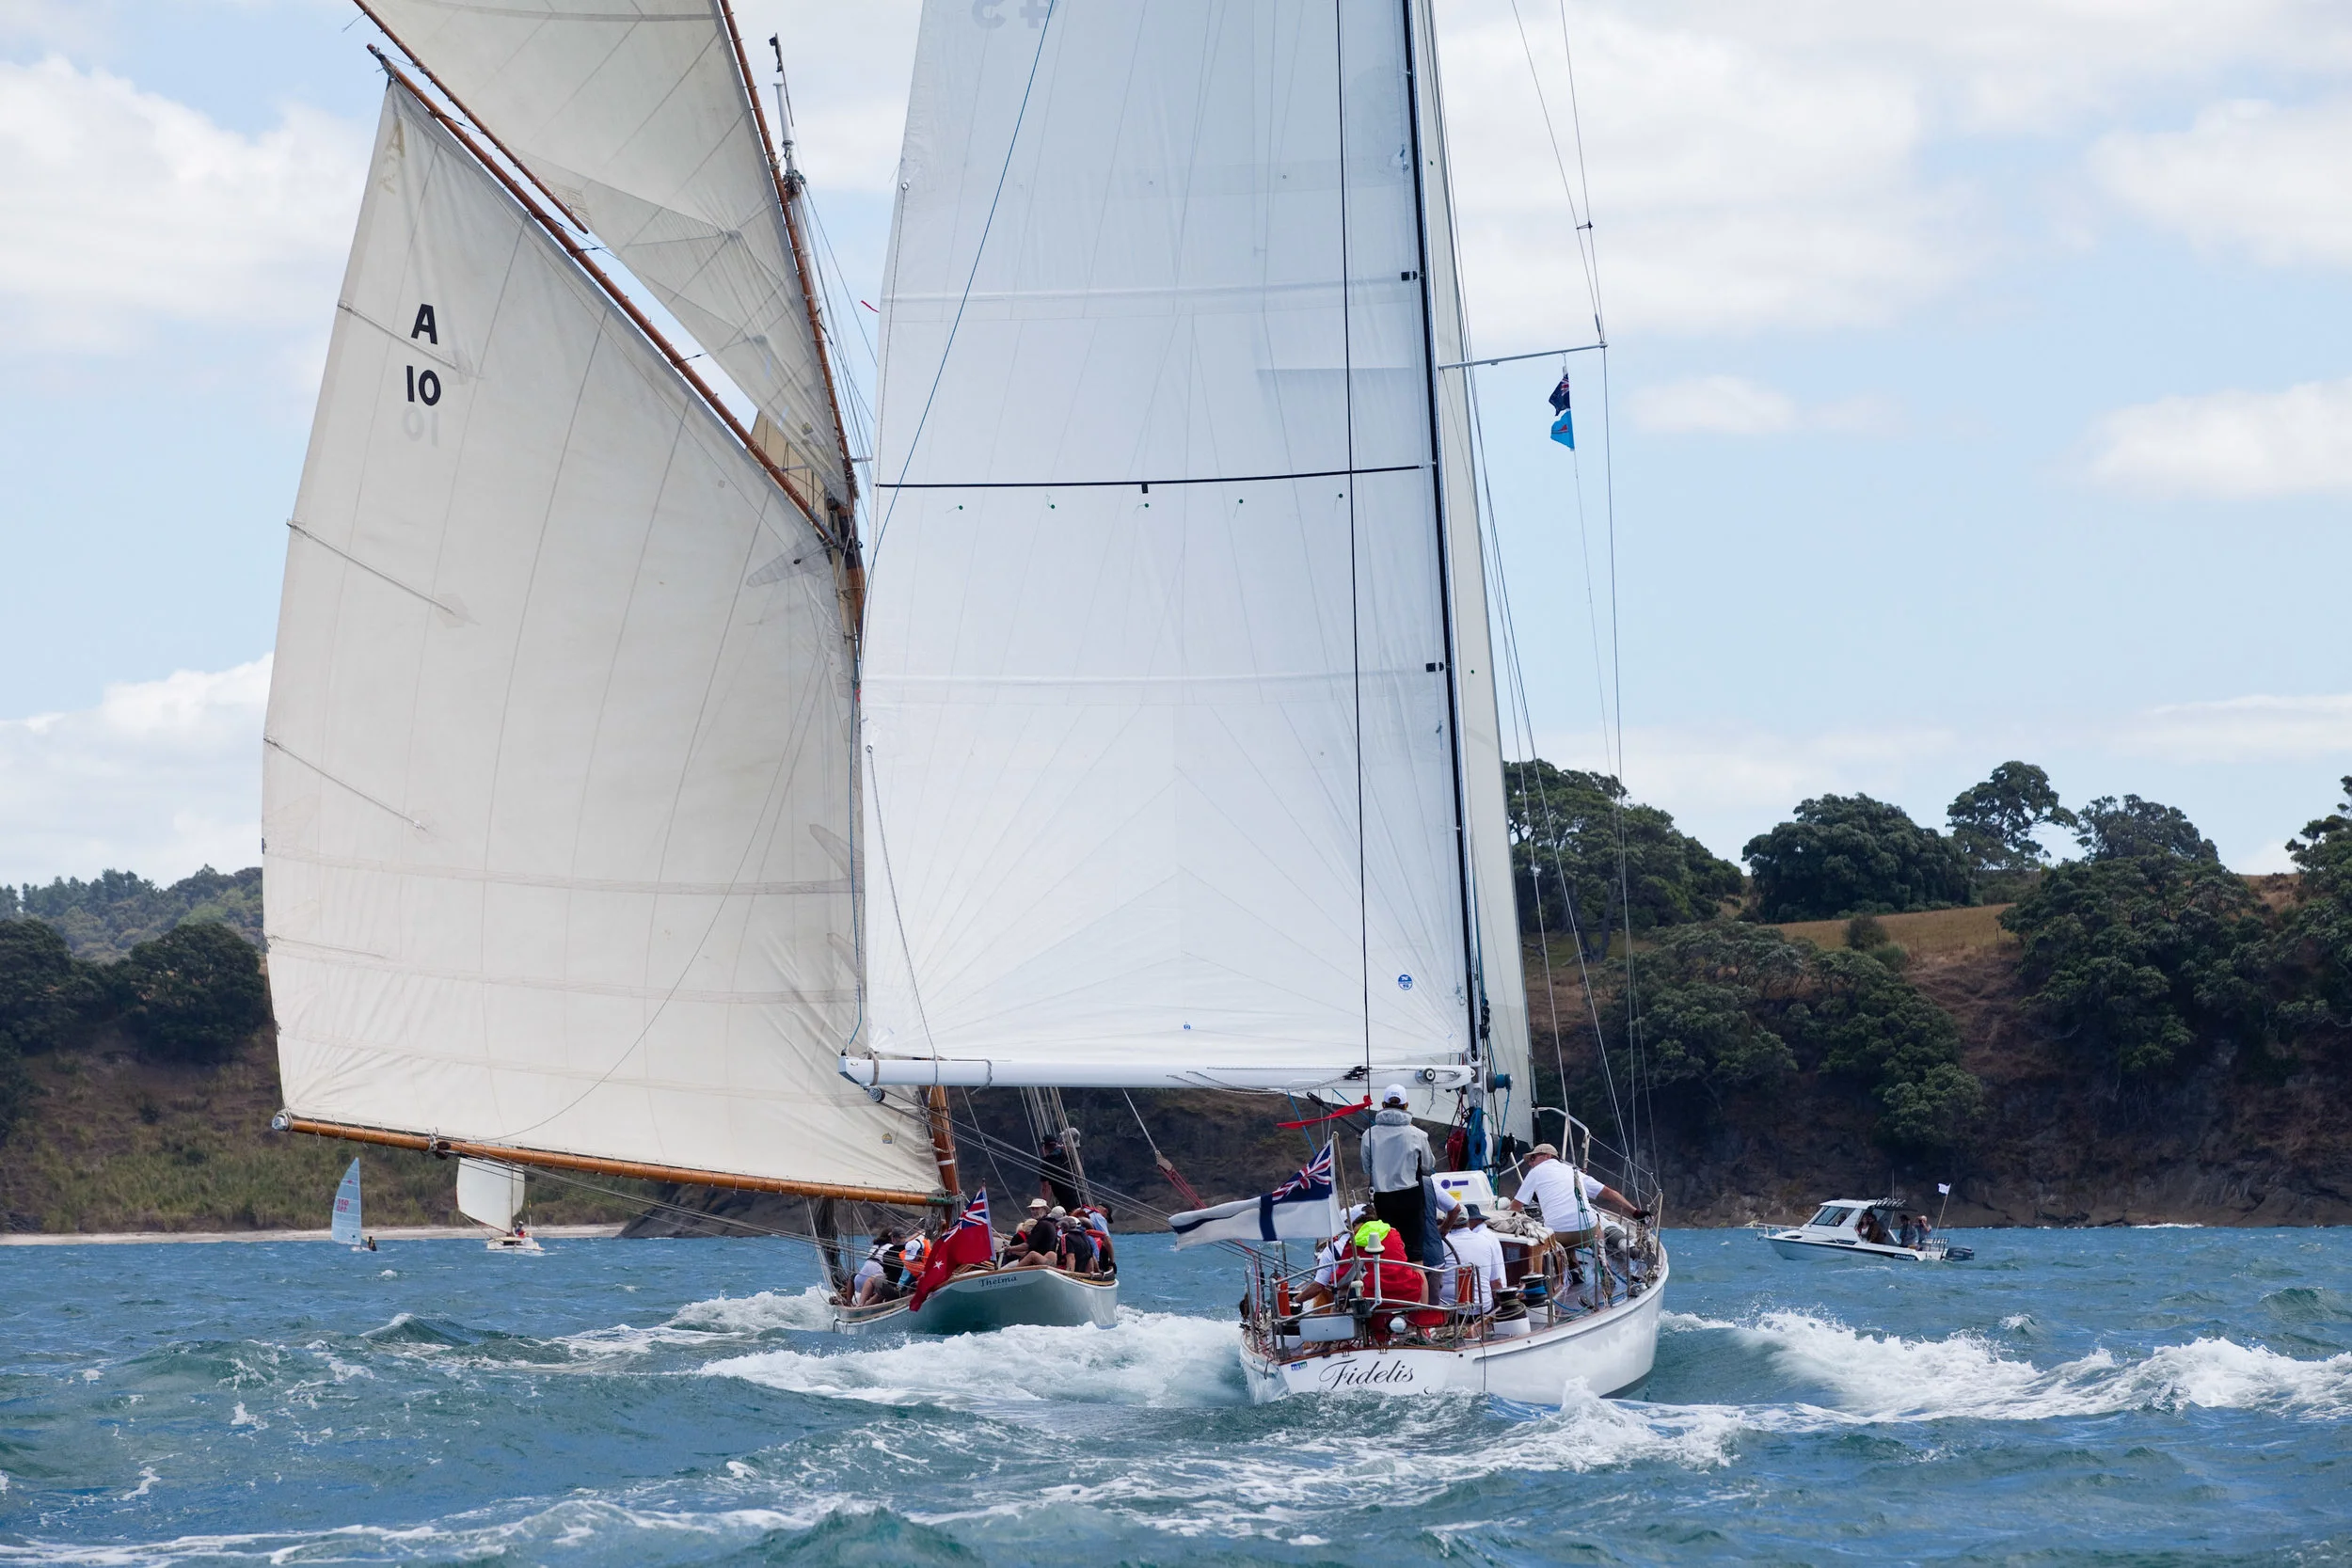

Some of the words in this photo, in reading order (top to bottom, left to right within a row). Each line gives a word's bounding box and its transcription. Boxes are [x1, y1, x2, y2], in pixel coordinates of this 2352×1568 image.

[411, 303, 438, 345] A
[406, 365, 441, 406] 10
[978, 1275, 1018, 1288] Thelma
[1319, 1357, 1414, 1390] Fidelis
